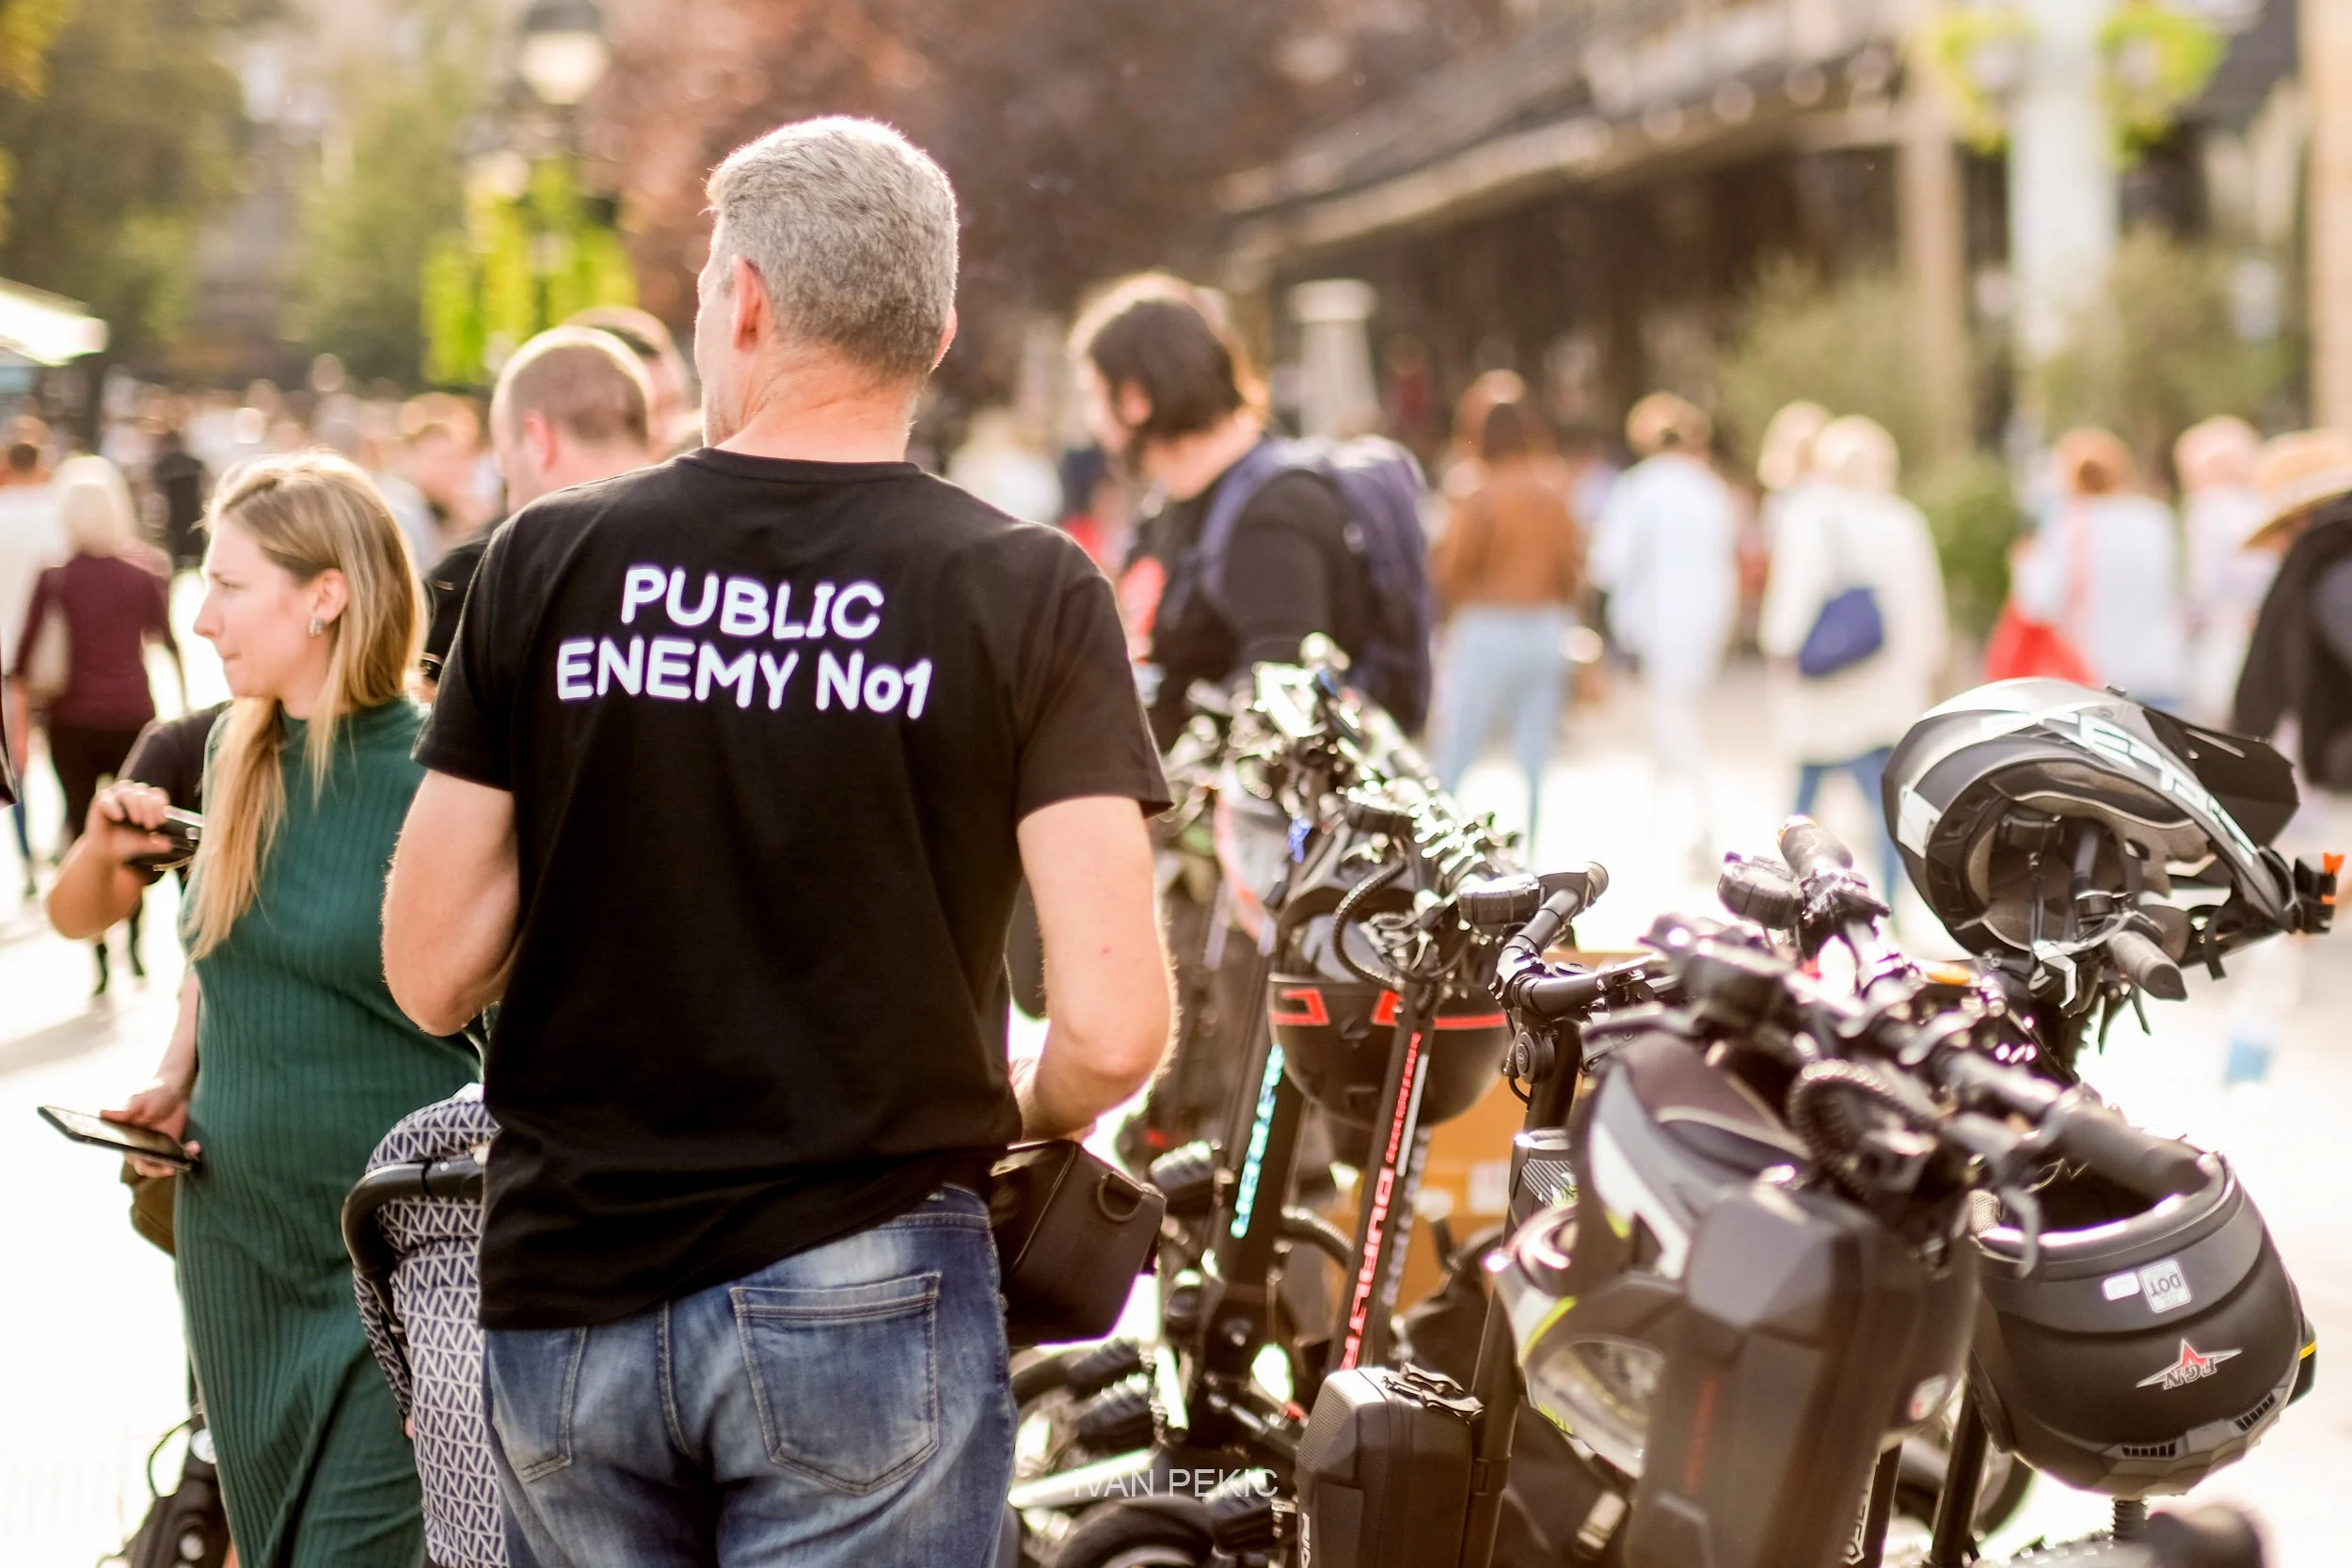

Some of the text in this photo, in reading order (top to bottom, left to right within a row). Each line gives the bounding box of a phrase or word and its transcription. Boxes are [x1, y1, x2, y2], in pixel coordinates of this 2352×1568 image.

[620, 565, 884, 641] PUBLIC
[557, 637, 932, 721] ENEMY No1
[2150, 1273, 2182, 1297] DOT
